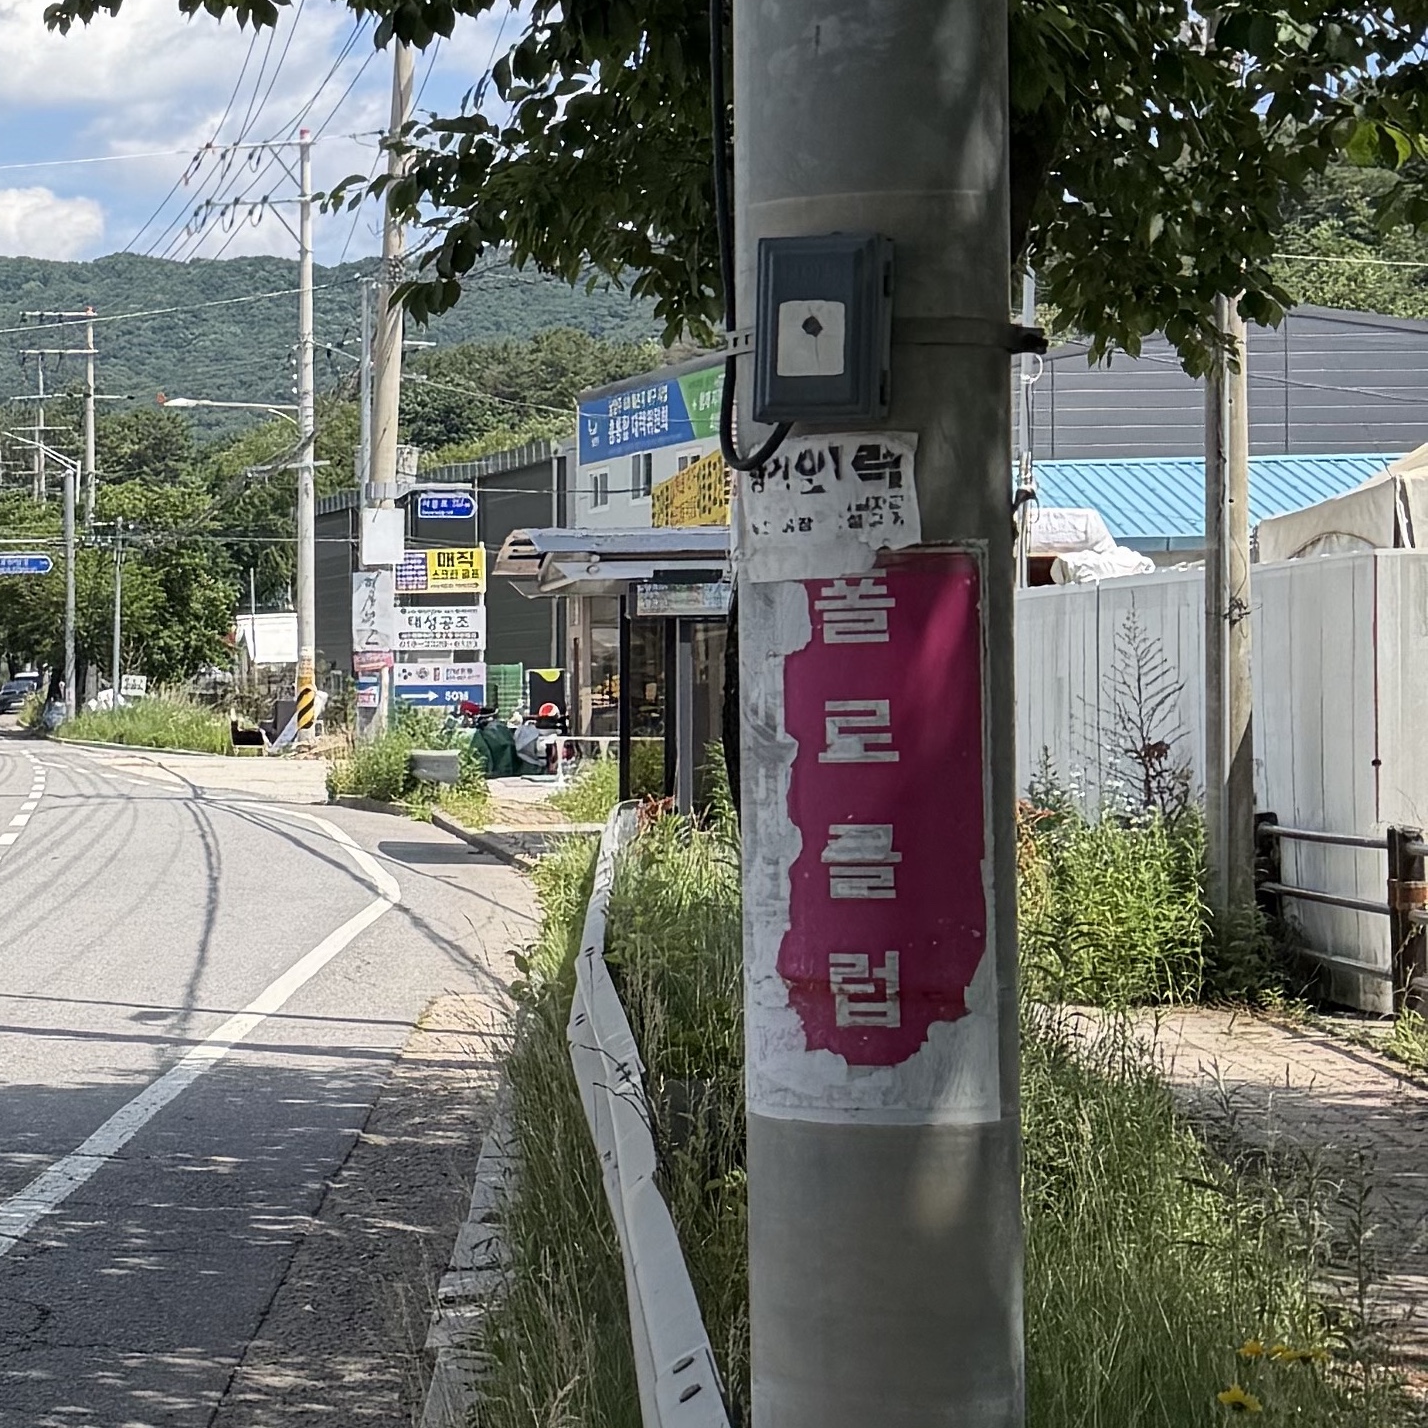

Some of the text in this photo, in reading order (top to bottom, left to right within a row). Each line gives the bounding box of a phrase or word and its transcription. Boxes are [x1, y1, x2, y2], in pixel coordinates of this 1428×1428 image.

[437, 551, 474, 568] 매직
[432, 569, 459, 580] 스크린
[407, 615, 470, 631] 태성공조
